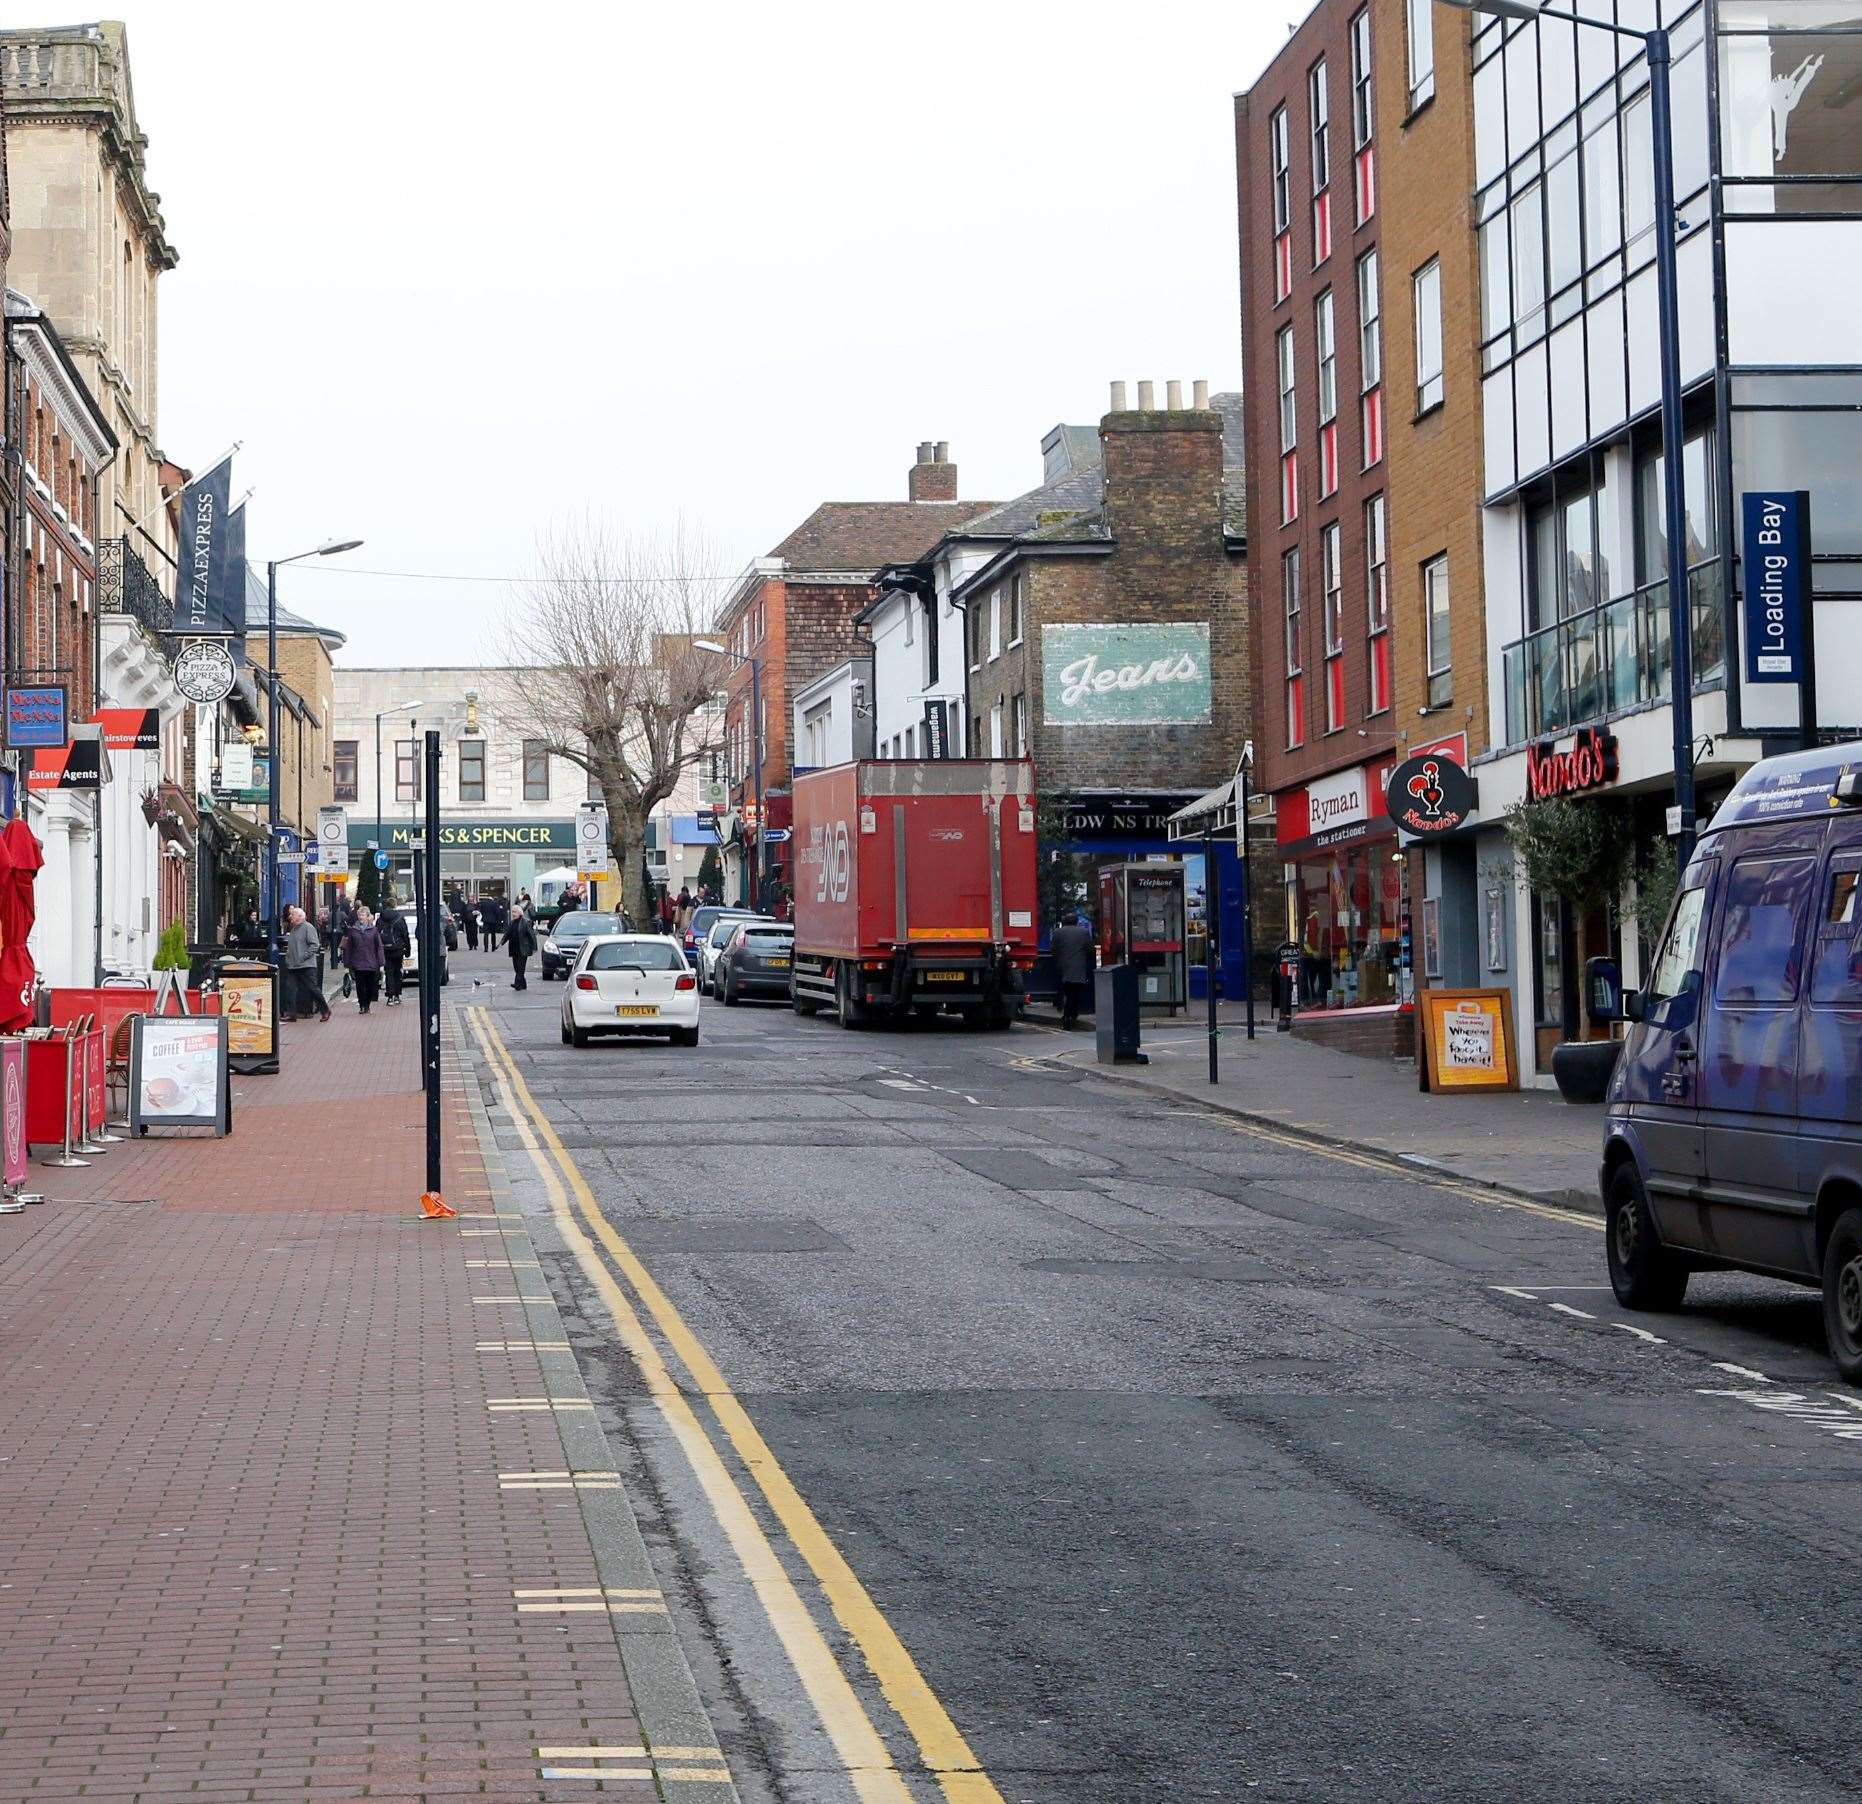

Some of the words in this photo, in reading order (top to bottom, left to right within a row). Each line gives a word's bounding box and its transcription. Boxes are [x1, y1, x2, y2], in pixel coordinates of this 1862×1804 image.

[1759, 500, 1786, 544] Bay
[191, 493, 213, 626] PIZZAEXPRESS
[1760, 556, 1788, 650] Loading
[183, 671, 226, 680] EXPRESS
[1060, 652, 1200, 707] Jeans
[104, 734, 135, 742] airstow
[137, 733, 157, 742] eves
[929, 706, 941, 759] wagamama
[1526, 725, 1604, 802] Nando's
[29, 770, 60, 780] Estate
[62, 770, 98, 782] Agents
[1311, 790, 1359, 824] Ryman
[1402, 808, 1459, 830] Nando's
[392, 828, 455, 843] MKS
[457, 828, 470, 843] &
[472, 828, 552, 843] SPENCER
[1317, 834, 1329, 846] the
[1330, 825, 1367, 843] stationer
[1139, 878, 1173, 887] Telephone
[228, 991, 242, 1014] 2
[152, 1042, 180, 1057] COFFEE
